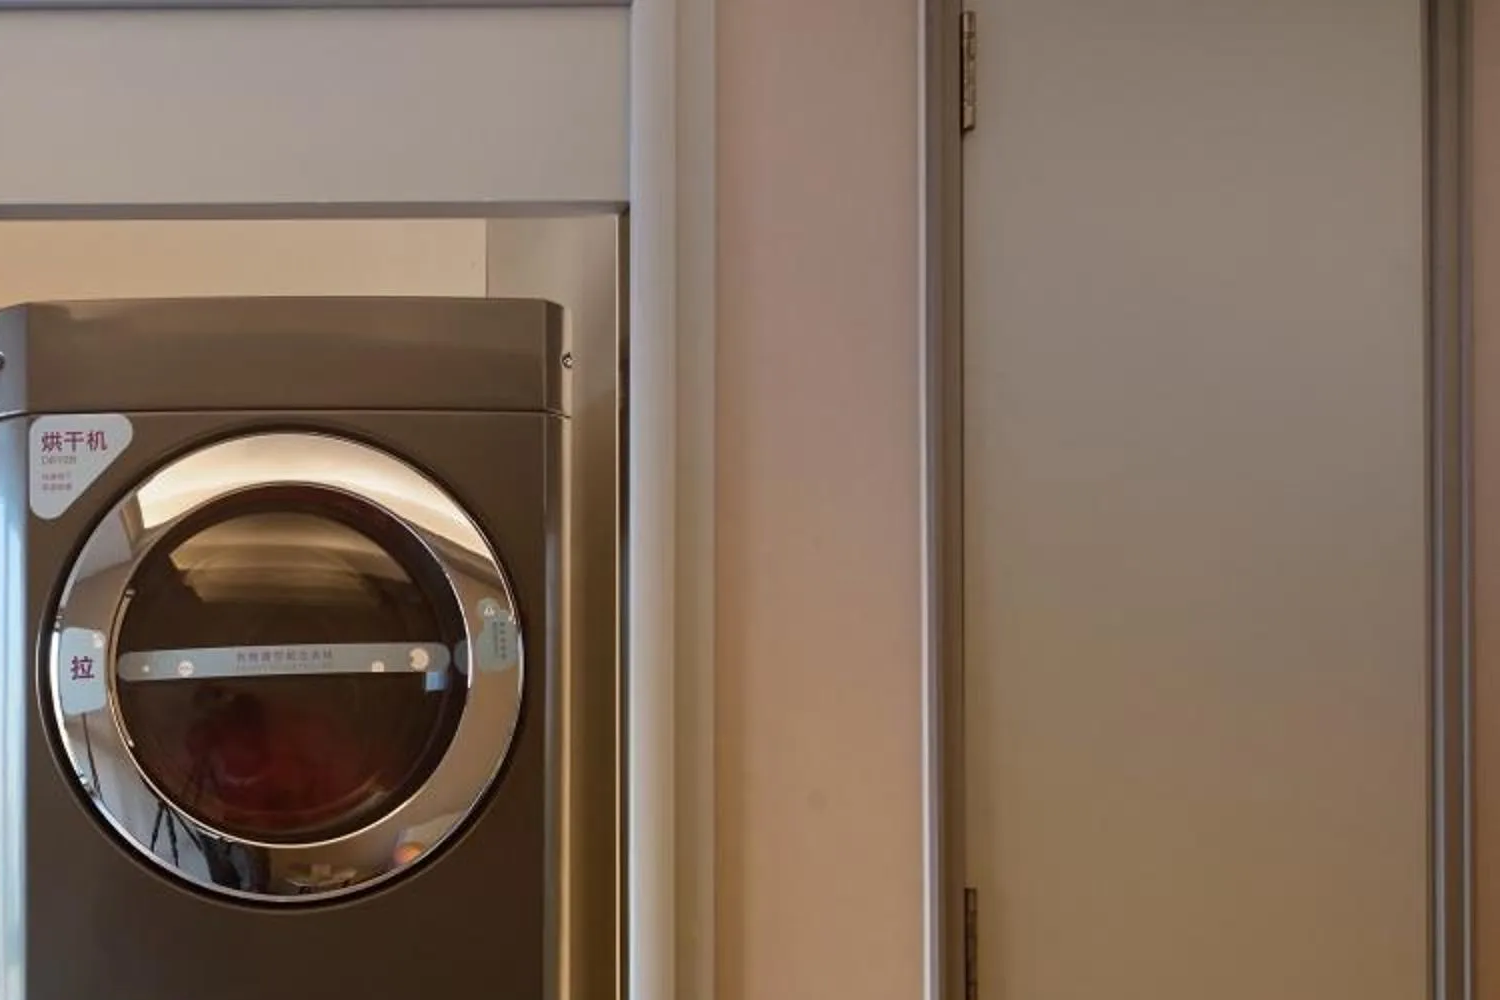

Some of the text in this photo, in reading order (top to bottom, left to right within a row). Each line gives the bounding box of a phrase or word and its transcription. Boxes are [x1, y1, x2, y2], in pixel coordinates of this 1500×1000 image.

[40, 430, 108, 453] 烘干机
[70, 655, 95, 680] 拉
